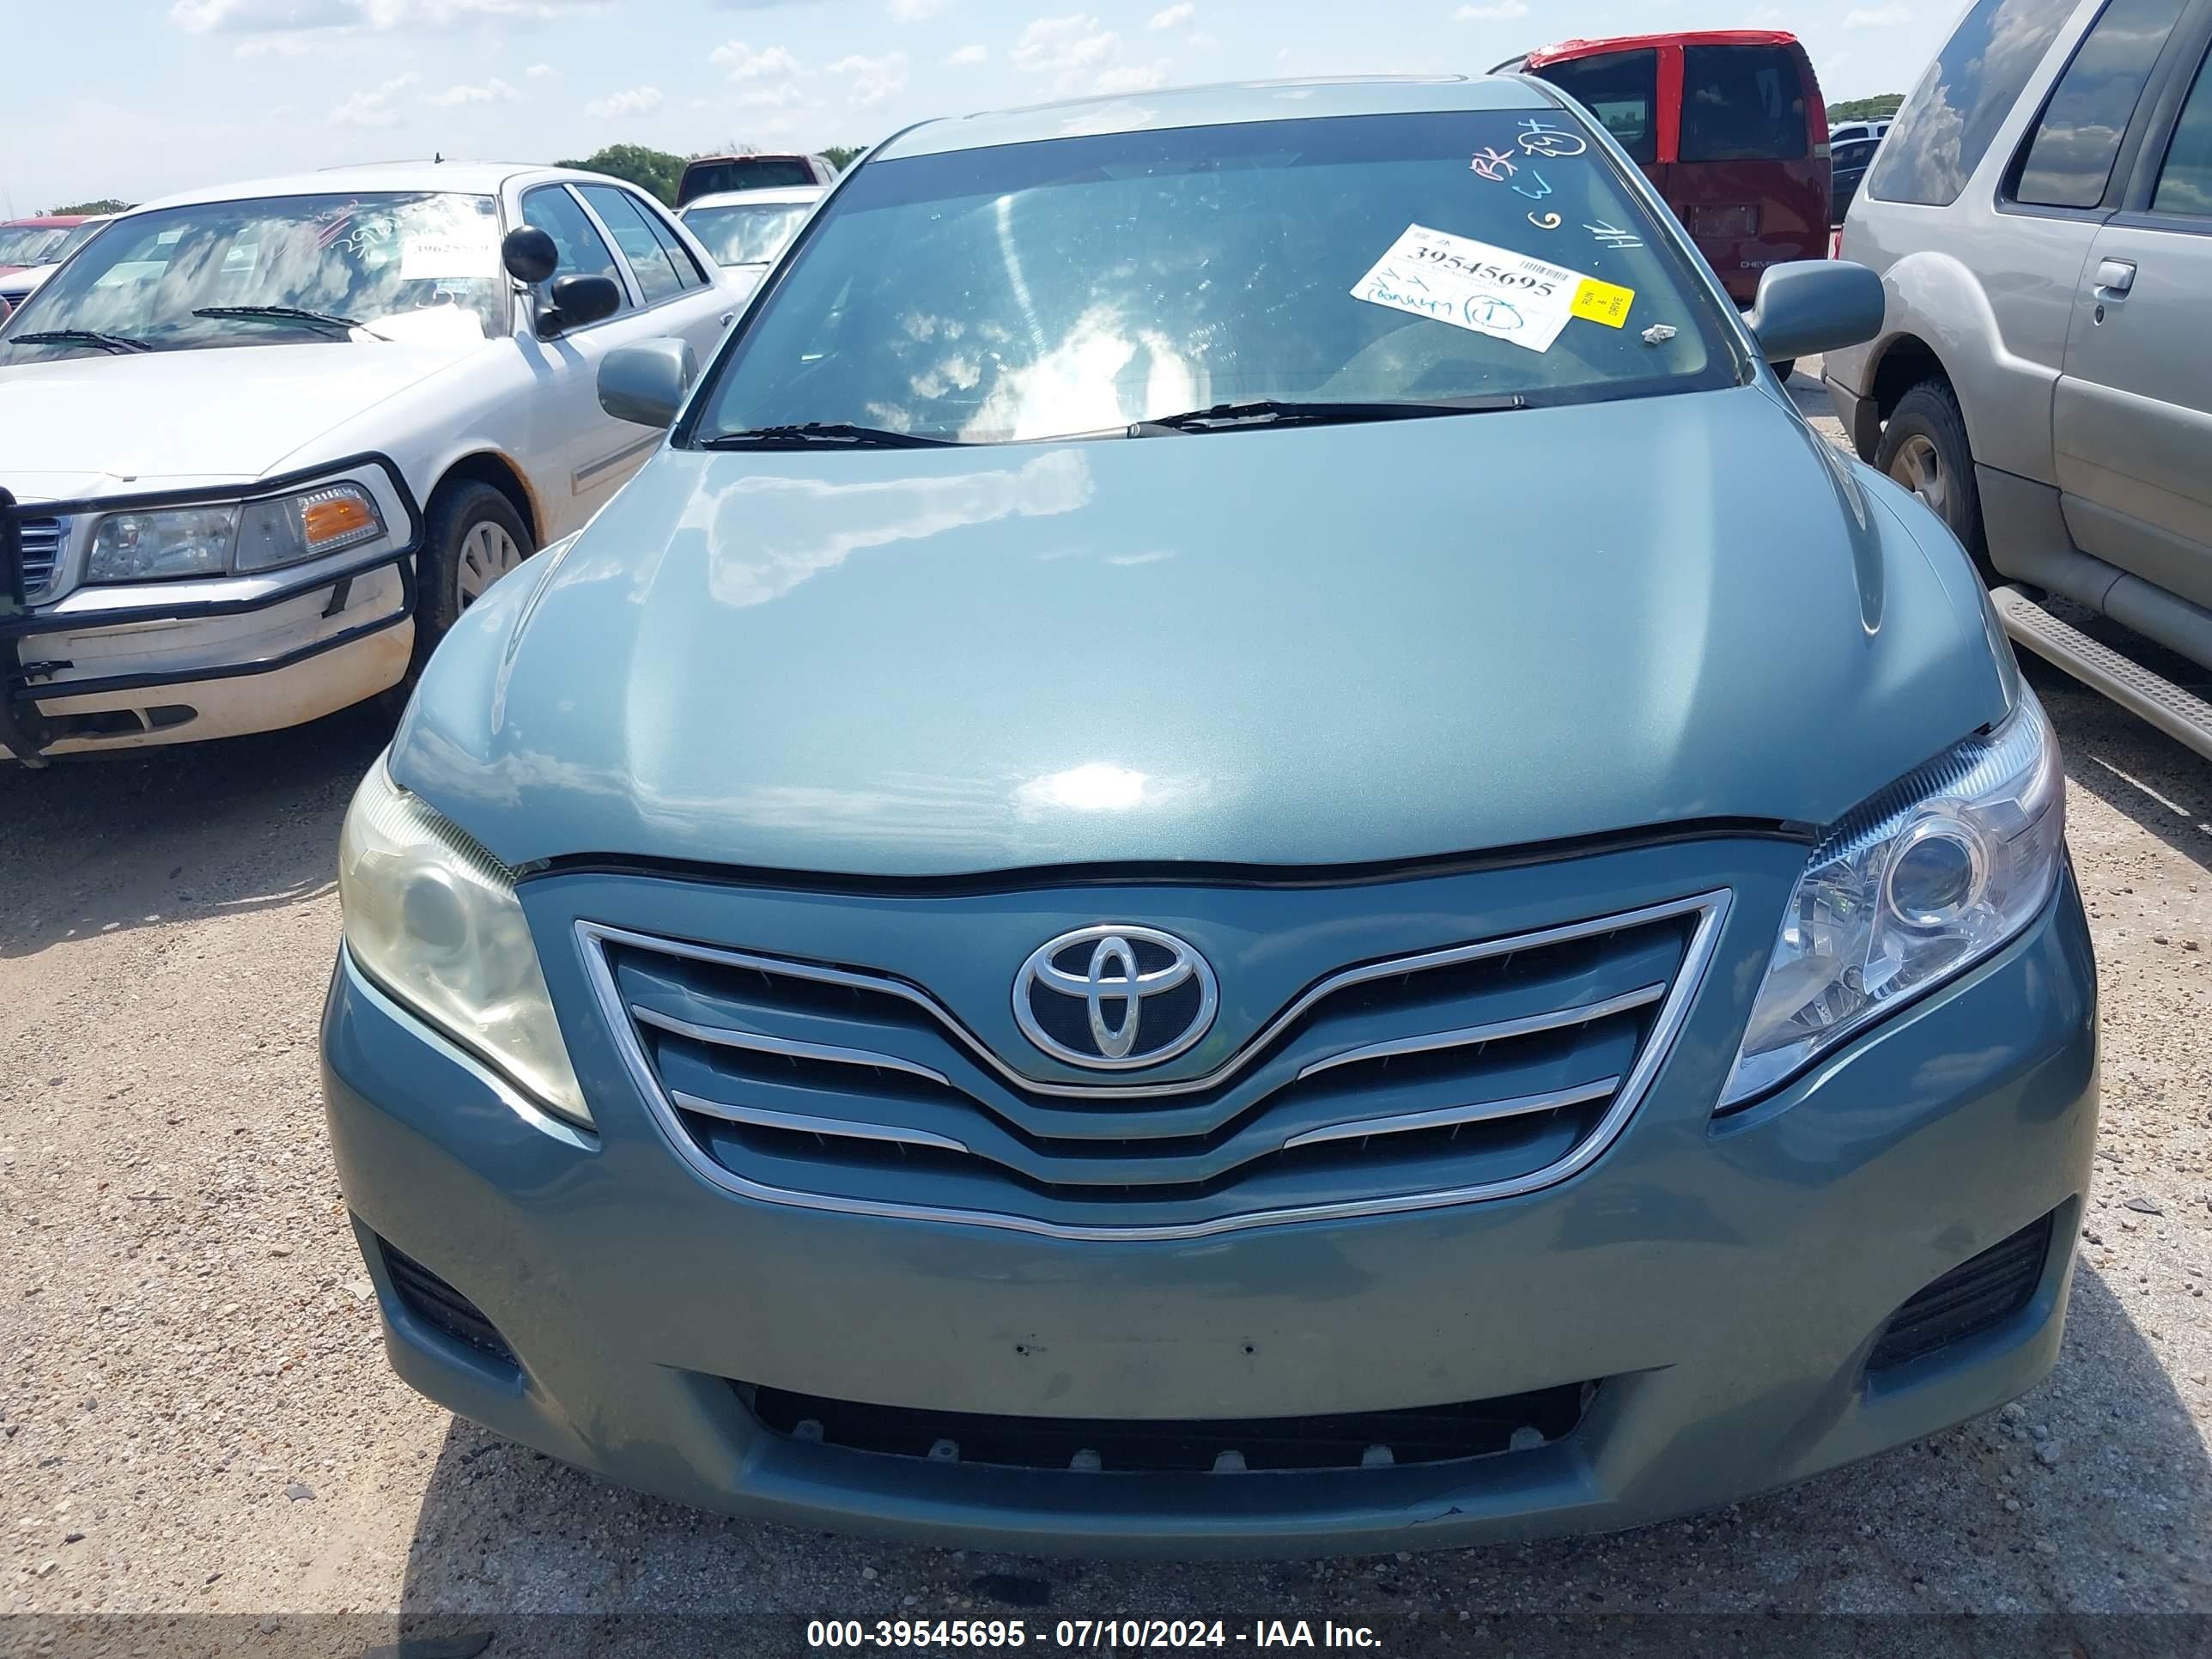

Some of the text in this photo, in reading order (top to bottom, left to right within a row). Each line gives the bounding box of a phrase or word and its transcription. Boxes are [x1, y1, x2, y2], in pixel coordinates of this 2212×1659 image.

[1407, 246, 1557, 296] 39545695
[1582, 291, 1595, 306] RUN
[1608, 296, 1624, 316] DRIVE
